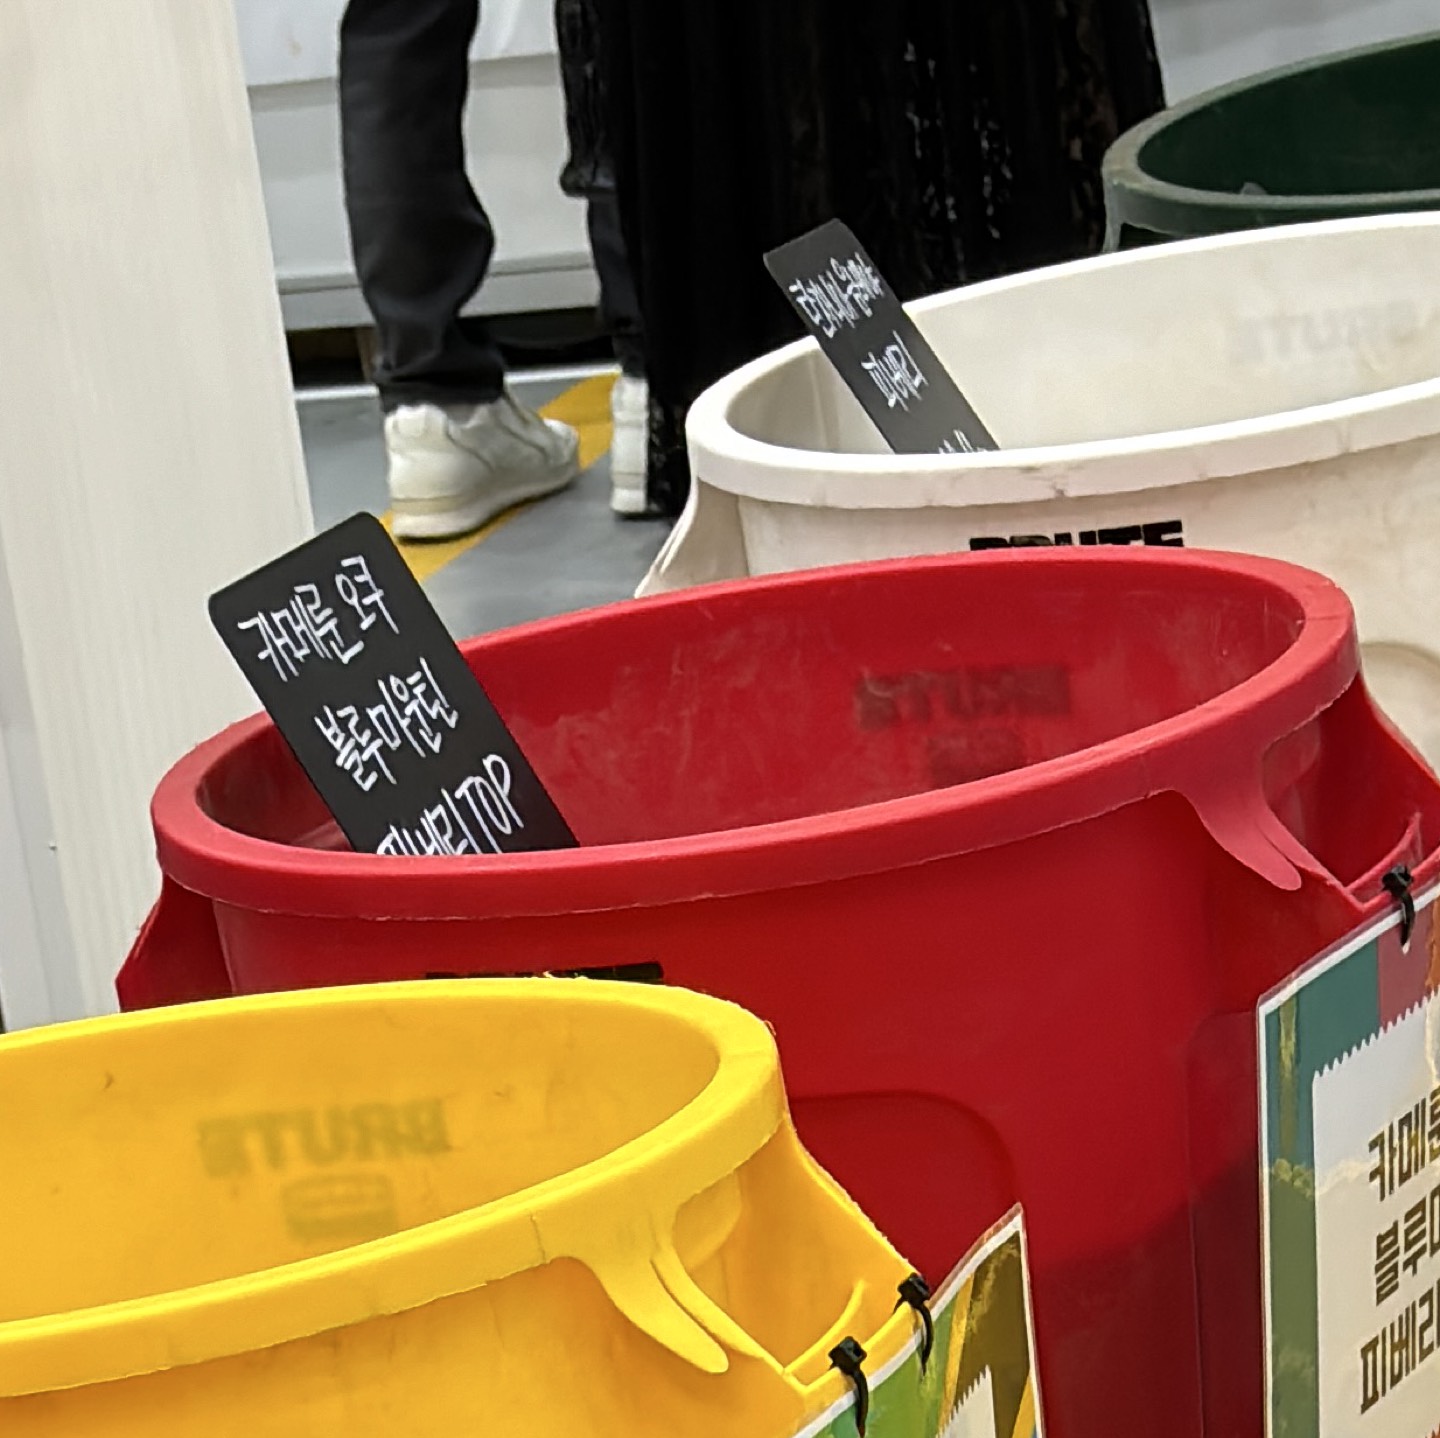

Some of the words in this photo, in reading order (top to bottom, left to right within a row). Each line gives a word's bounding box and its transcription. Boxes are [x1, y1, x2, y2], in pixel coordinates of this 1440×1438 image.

[862, 330, 930, 412] 피베리
[237, 582, 364, 682] 카메룬
[314, 656, 459, 792] 블루마운틴
[455, 753, 524, 854] TOP
